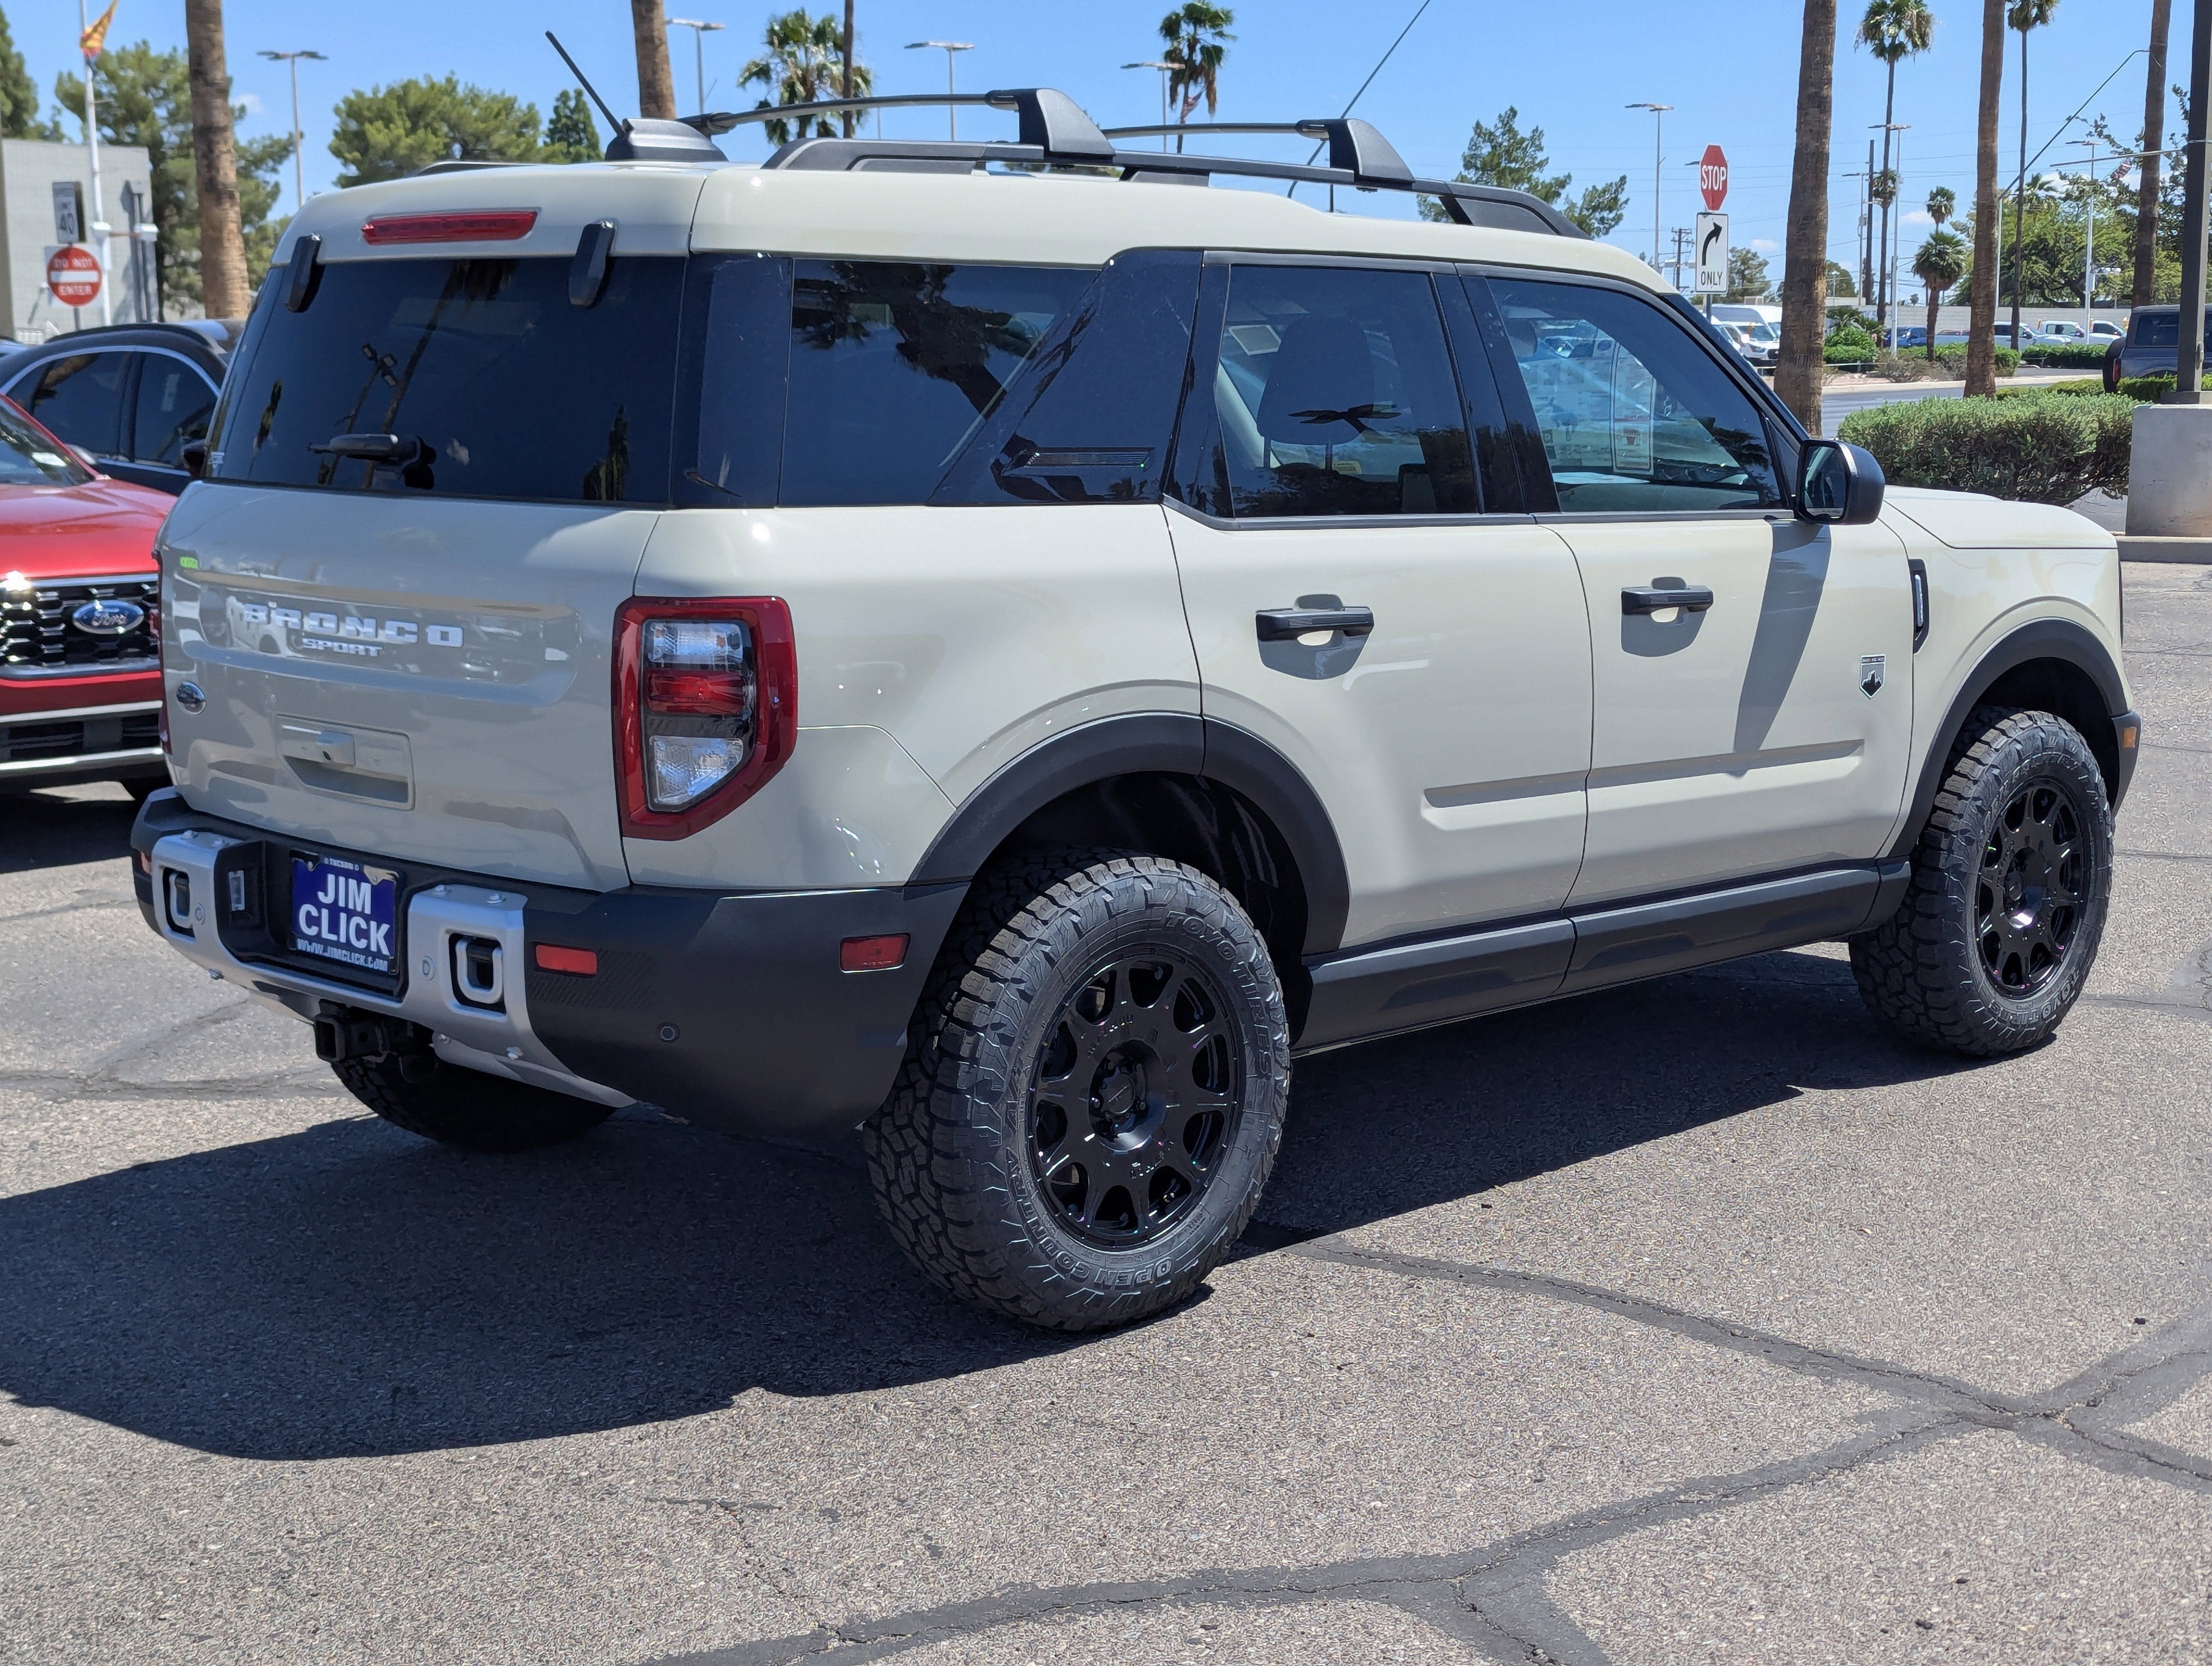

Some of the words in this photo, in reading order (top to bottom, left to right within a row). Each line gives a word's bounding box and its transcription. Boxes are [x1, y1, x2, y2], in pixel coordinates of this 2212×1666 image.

[1701, 164, 1727, 190] STOP
[54, 258, 69, 268] DO
[72, 257, 93, 268] NOT
[58, 285, 92, 296] ENTER
[1700, 271, 1723, 286] ONLY
[243, 603, 464, 648] BRONCO
[302, 638, 383, 657] SPORT
[317, 873, 372, 915] JIM
[299, 904, 391, 957] CLICK
[1166, 910, 1237, 960] TOYO
[1230, 960, 1272, 1081] TIRES
[1094, 1256, 1173, 1289] OPEN
